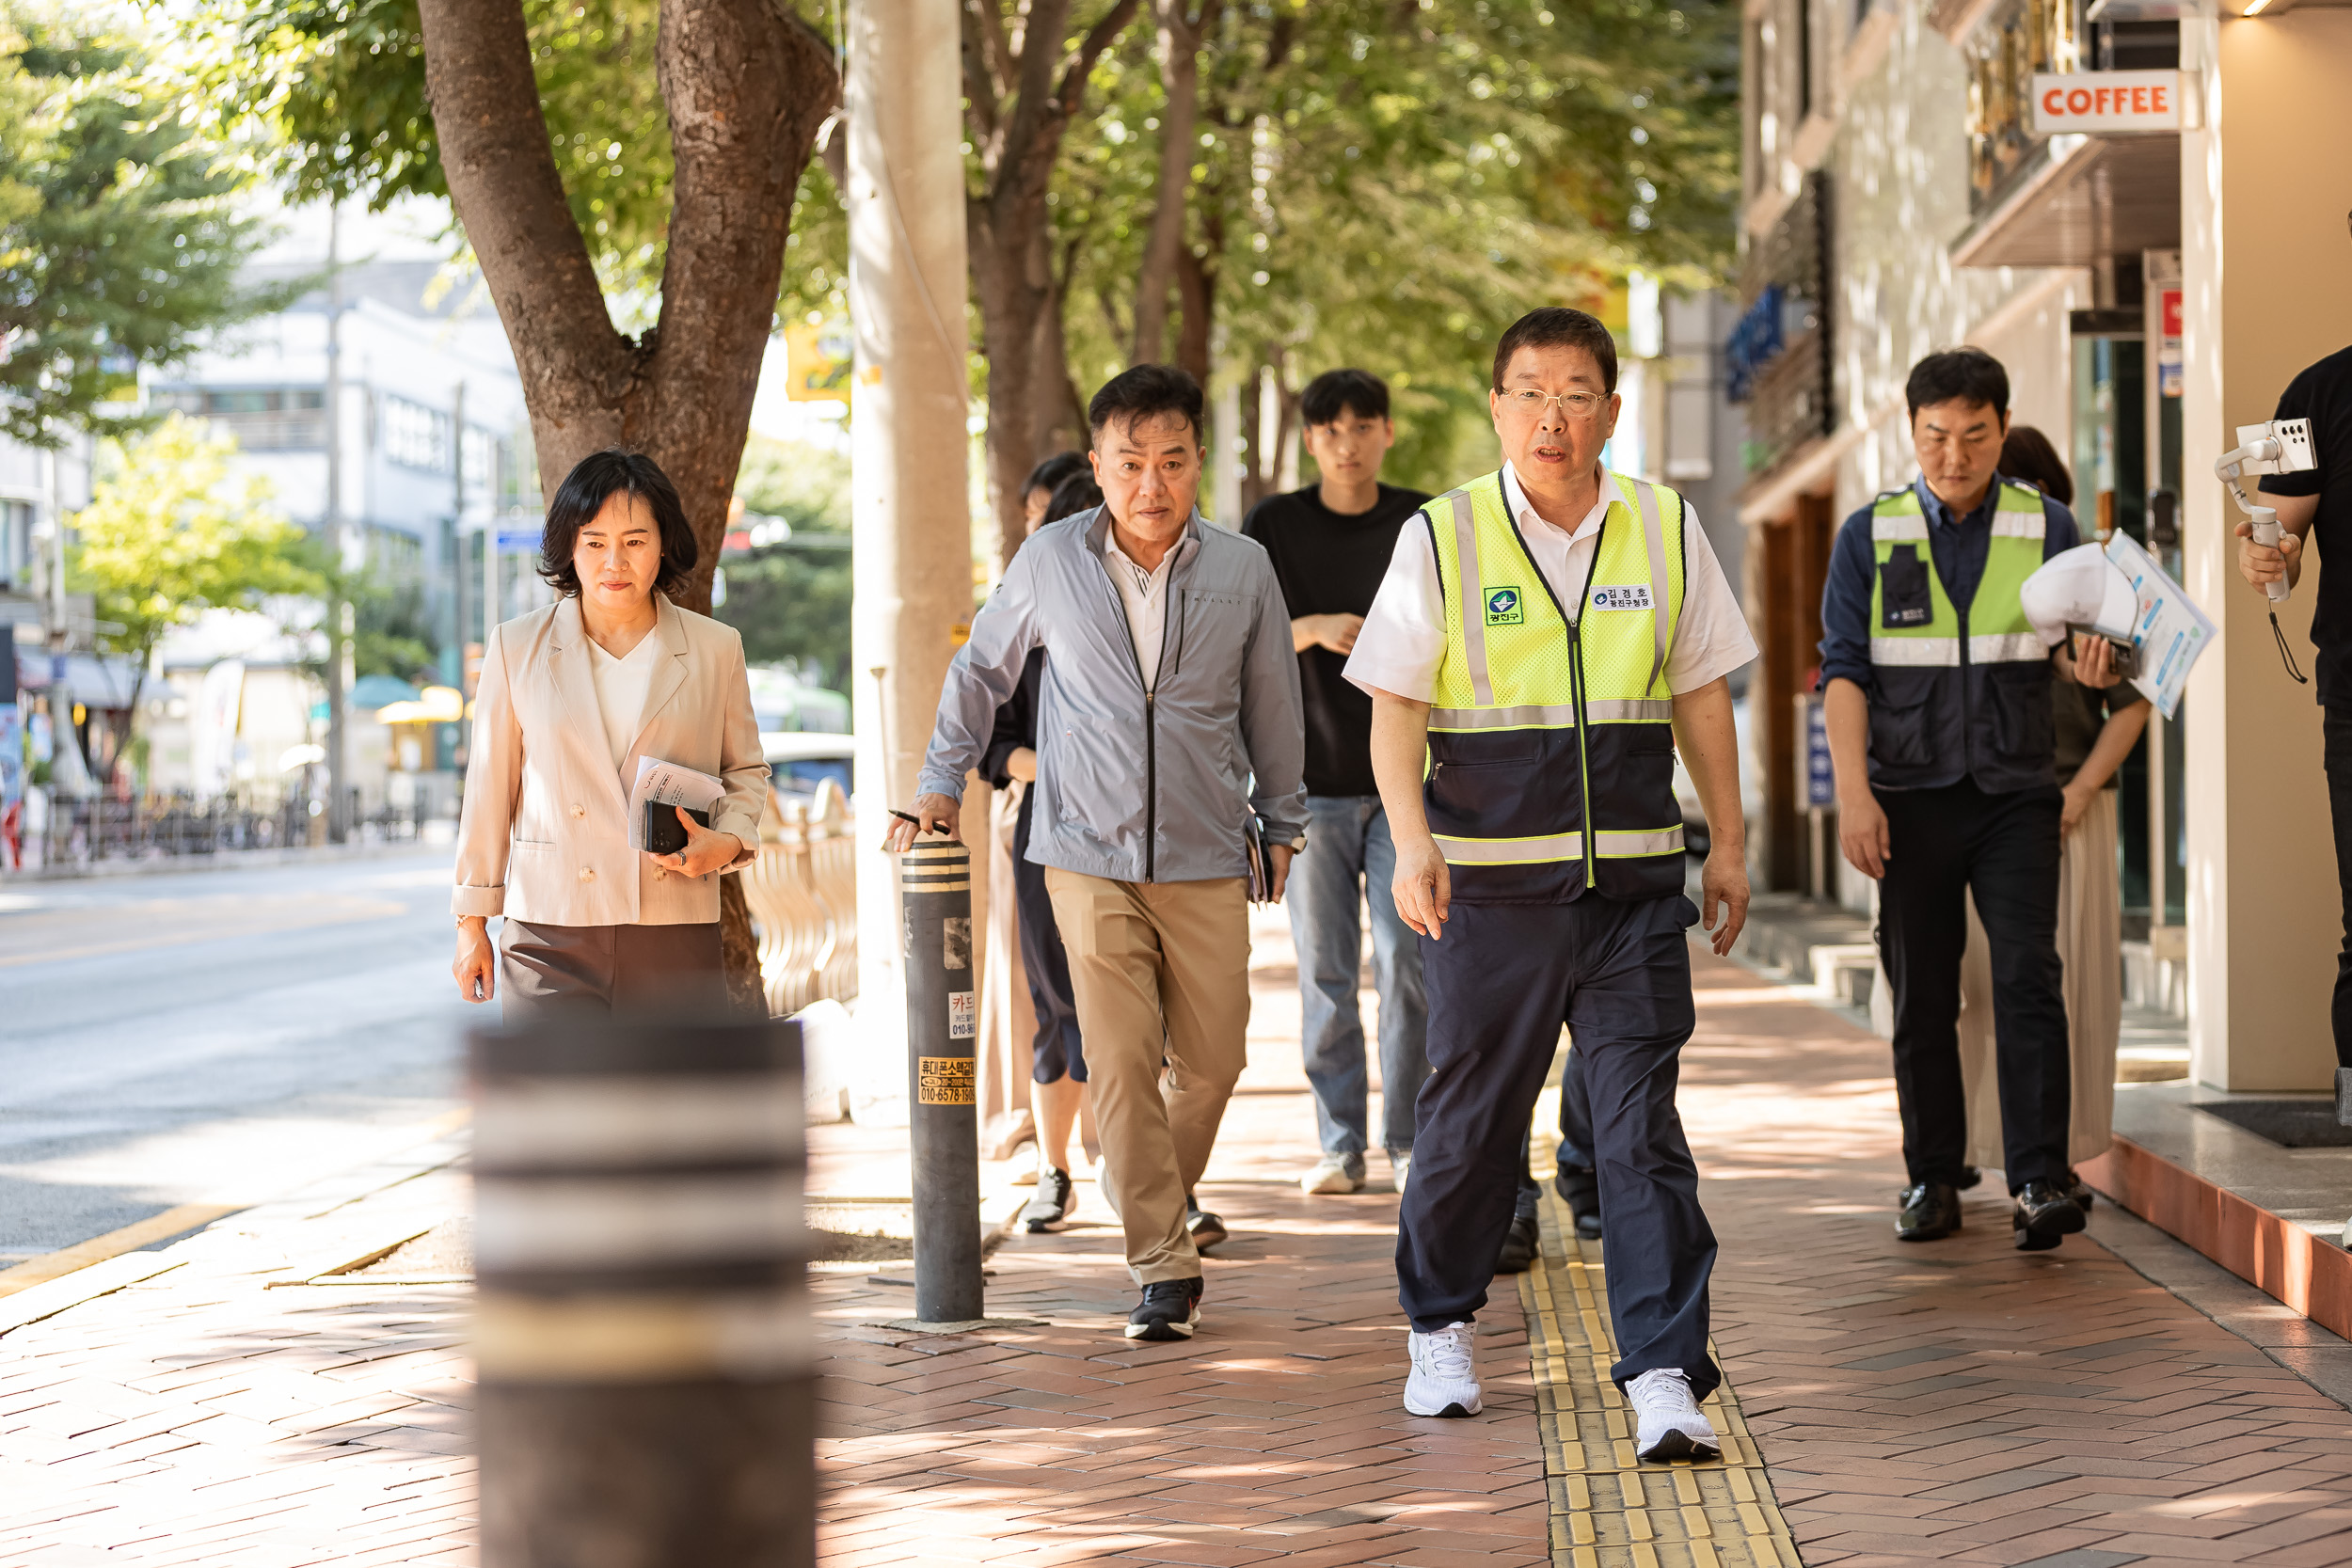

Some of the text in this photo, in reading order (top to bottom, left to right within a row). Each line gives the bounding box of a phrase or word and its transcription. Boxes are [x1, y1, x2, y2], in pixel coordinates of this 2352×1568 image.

[2042, 87, 2169, 117] COFFEE
[1610, 598, 1649, 608] 광진구청장
[1489, 613, 1519, 623] 광진구
